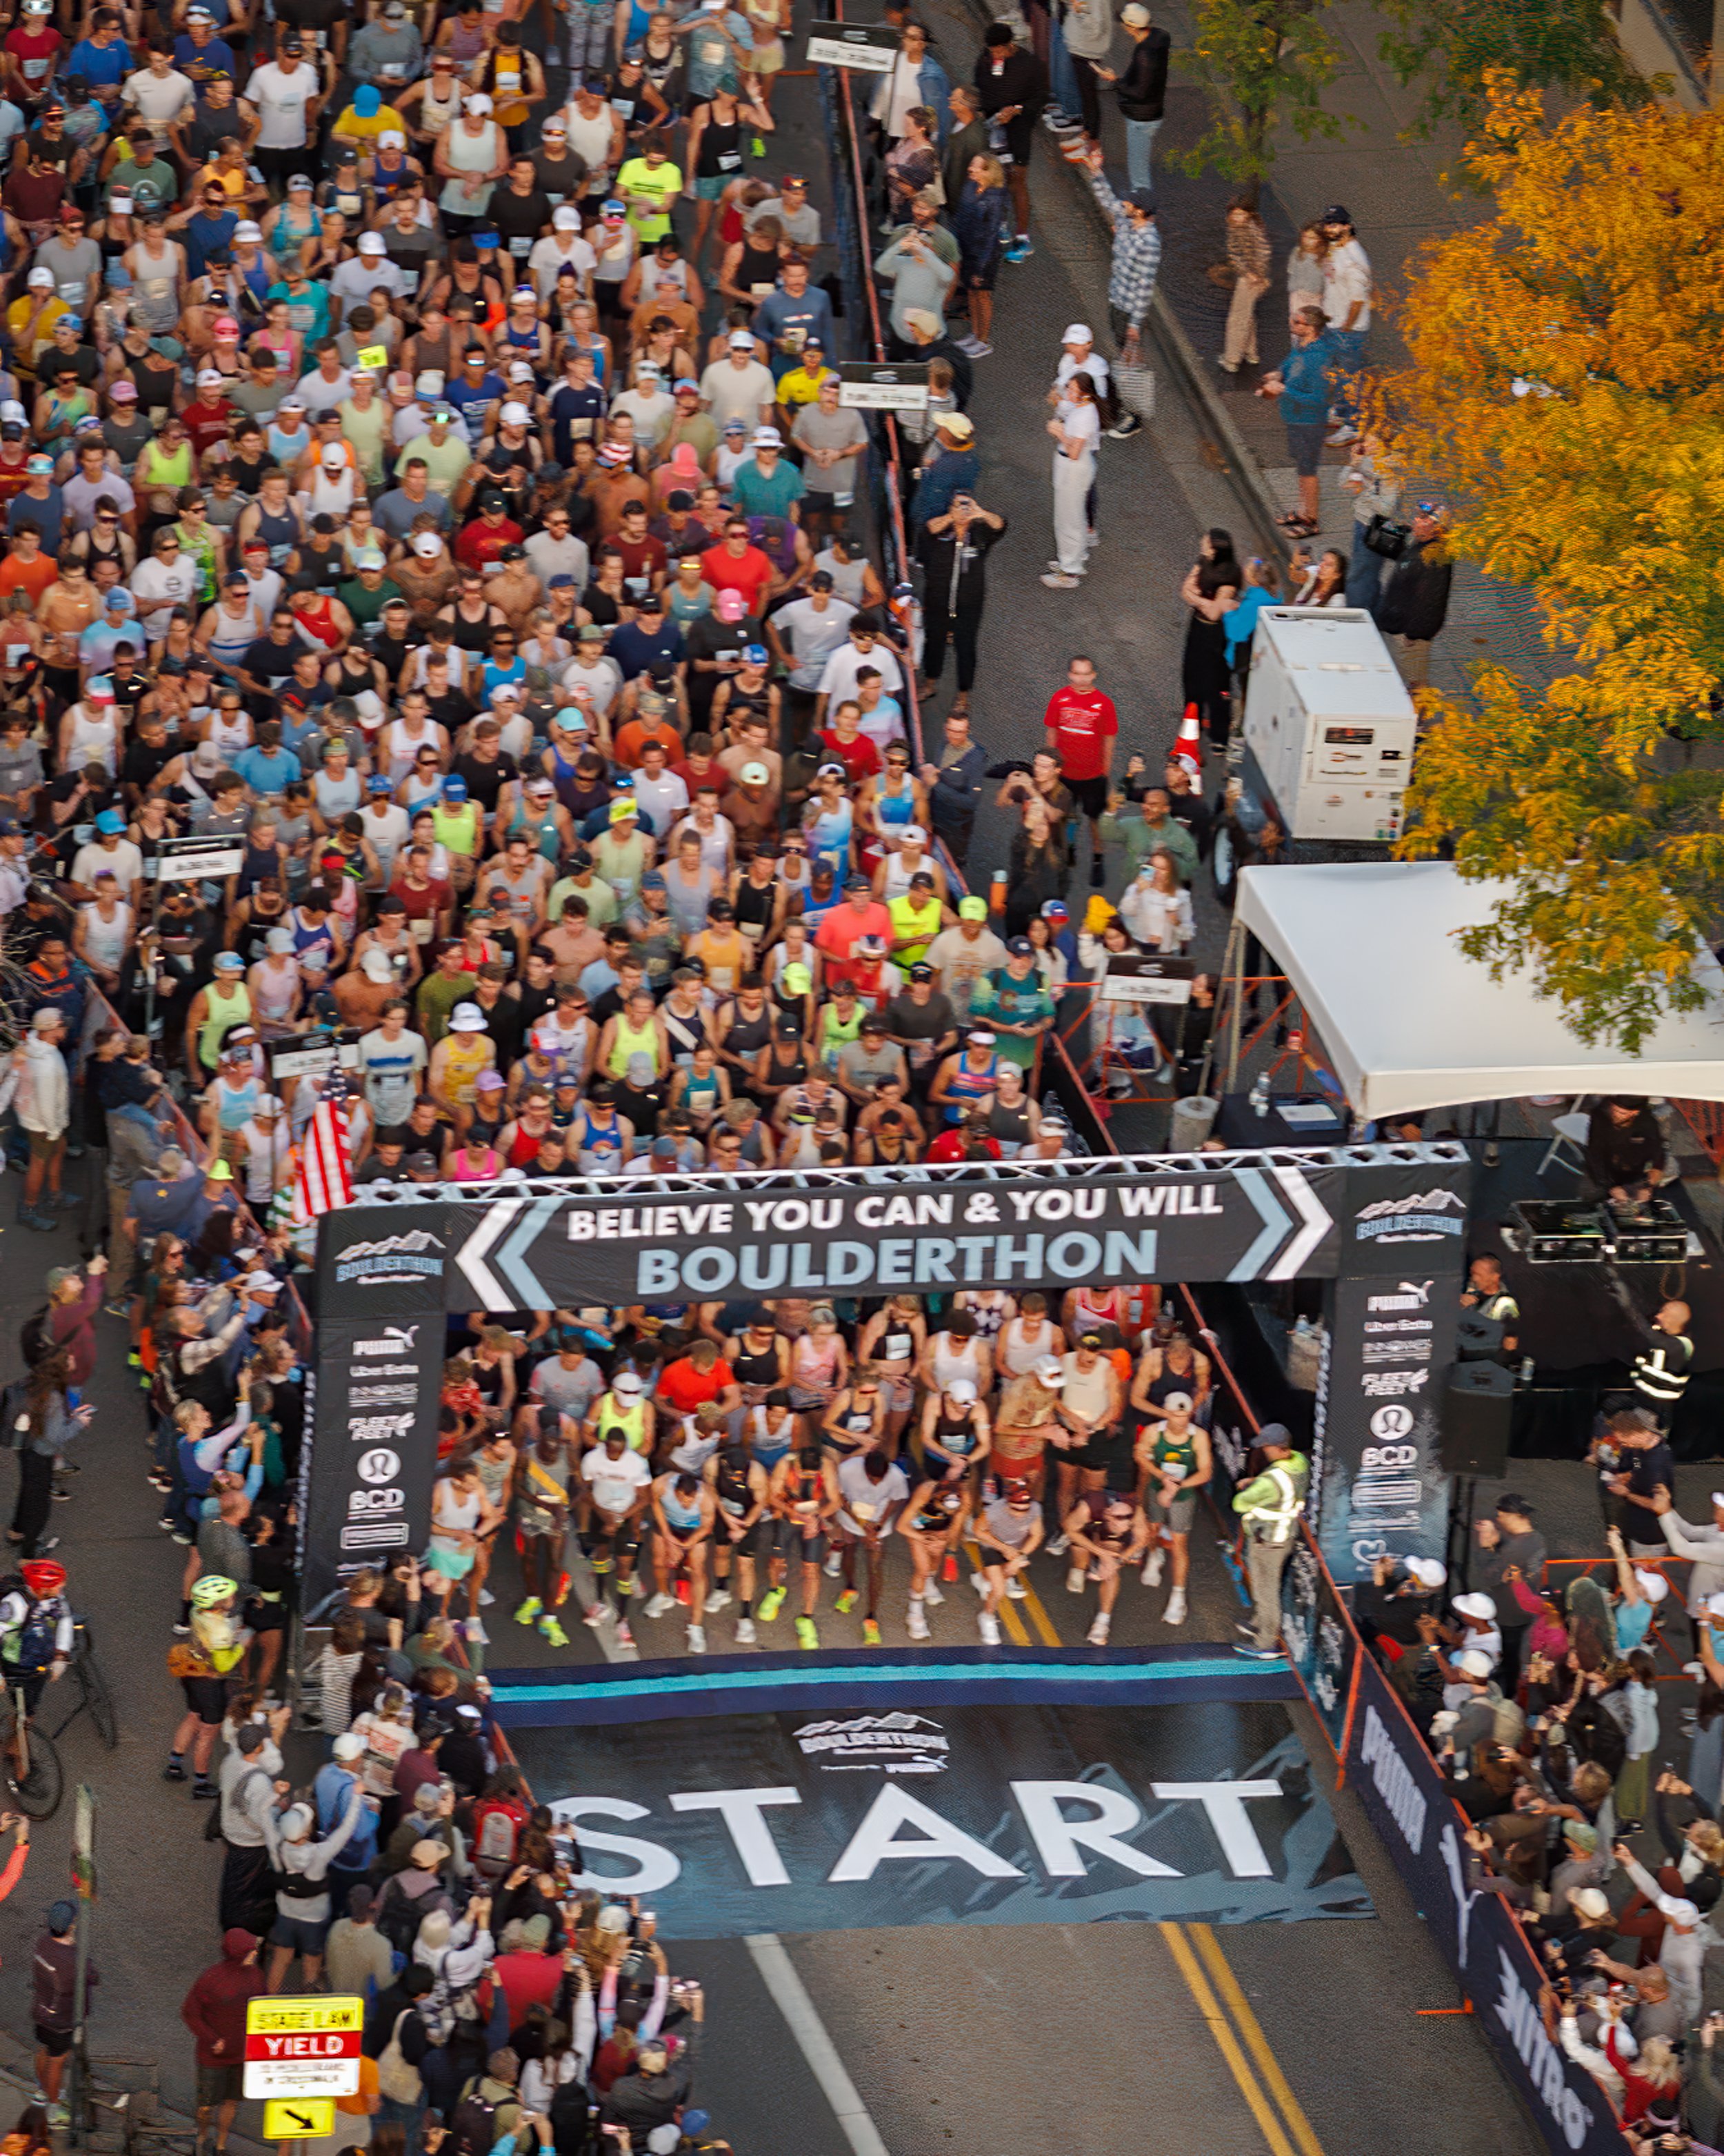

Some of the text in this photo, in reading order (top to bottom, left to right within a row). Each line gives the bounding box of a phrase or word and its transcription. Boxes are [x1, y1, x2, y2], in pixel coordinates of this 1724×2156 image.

[568, 1184, 1223, 1241] BELIEVE YOU CAN & YOU WILL
[637, 1229, 1158, 1295] BOULDERTHON
[1361, 1445, 1419, 1466] BCD
[348, 1488, 405, 1510] BCD
[545, 1780, 1283, 1895] START
[264, 2035, 344, 2055] YIELD
